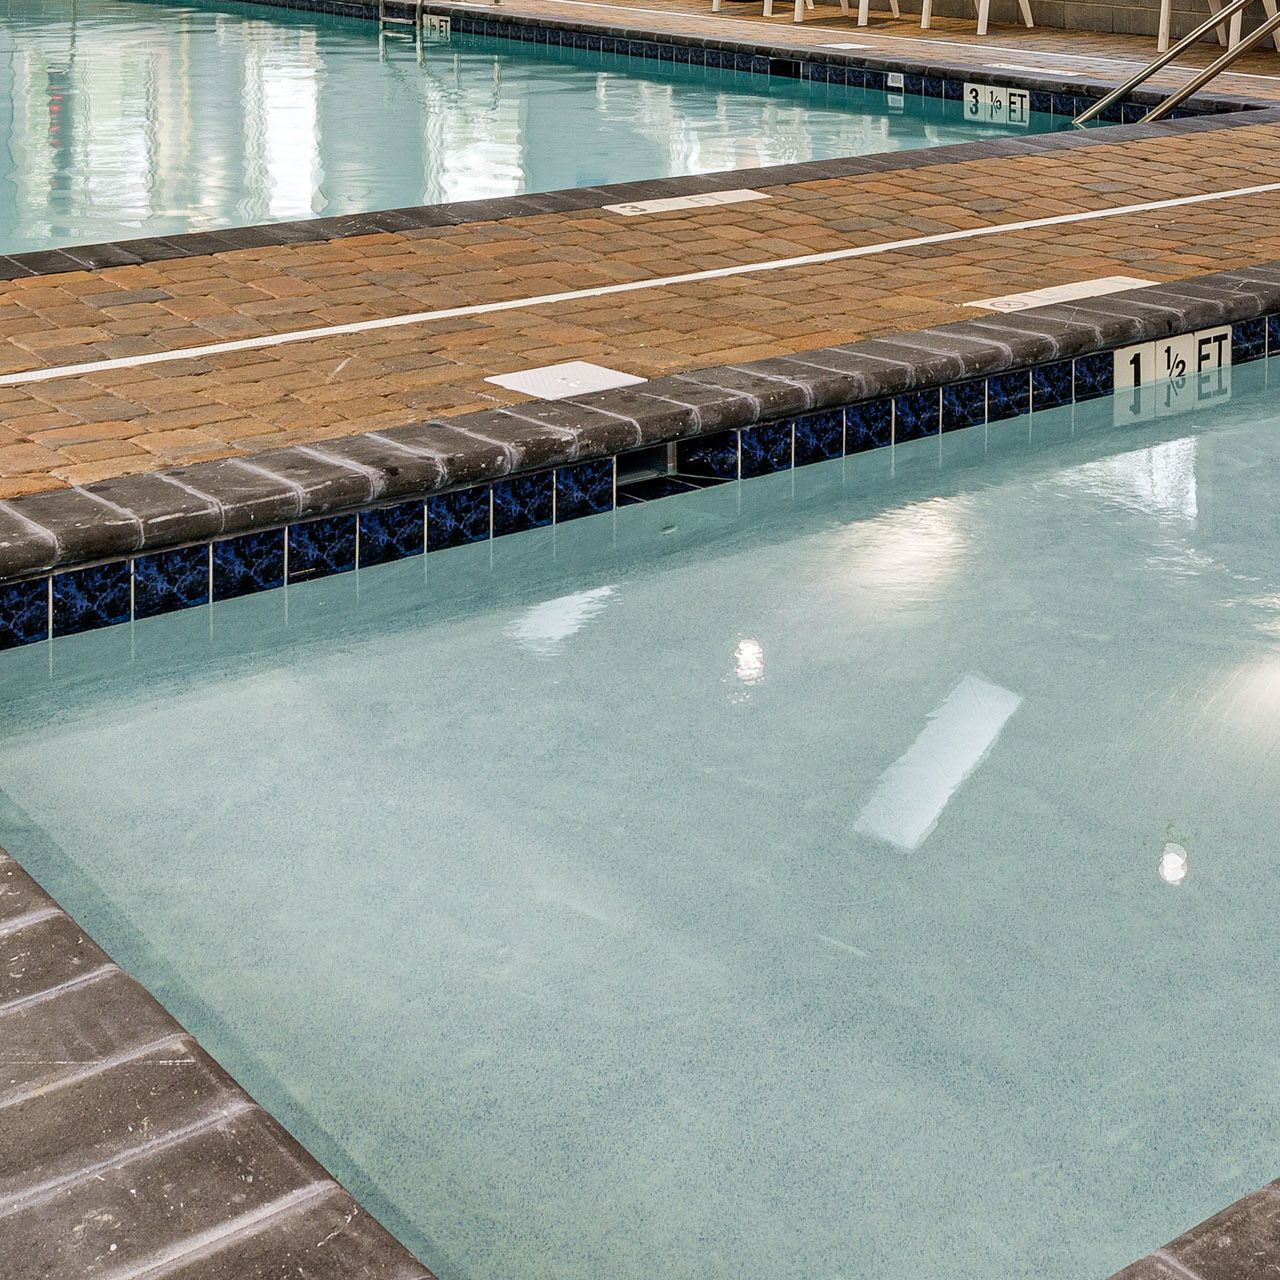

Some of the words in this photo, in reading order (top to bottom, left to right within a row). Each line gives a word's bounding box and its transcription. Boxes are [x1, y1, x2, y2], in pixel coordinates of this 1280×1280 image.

[1009, 93, 1027, 109] FT
[1129, 352, 1142, 387] 1
[1197, 332, 1229, 373] FT
